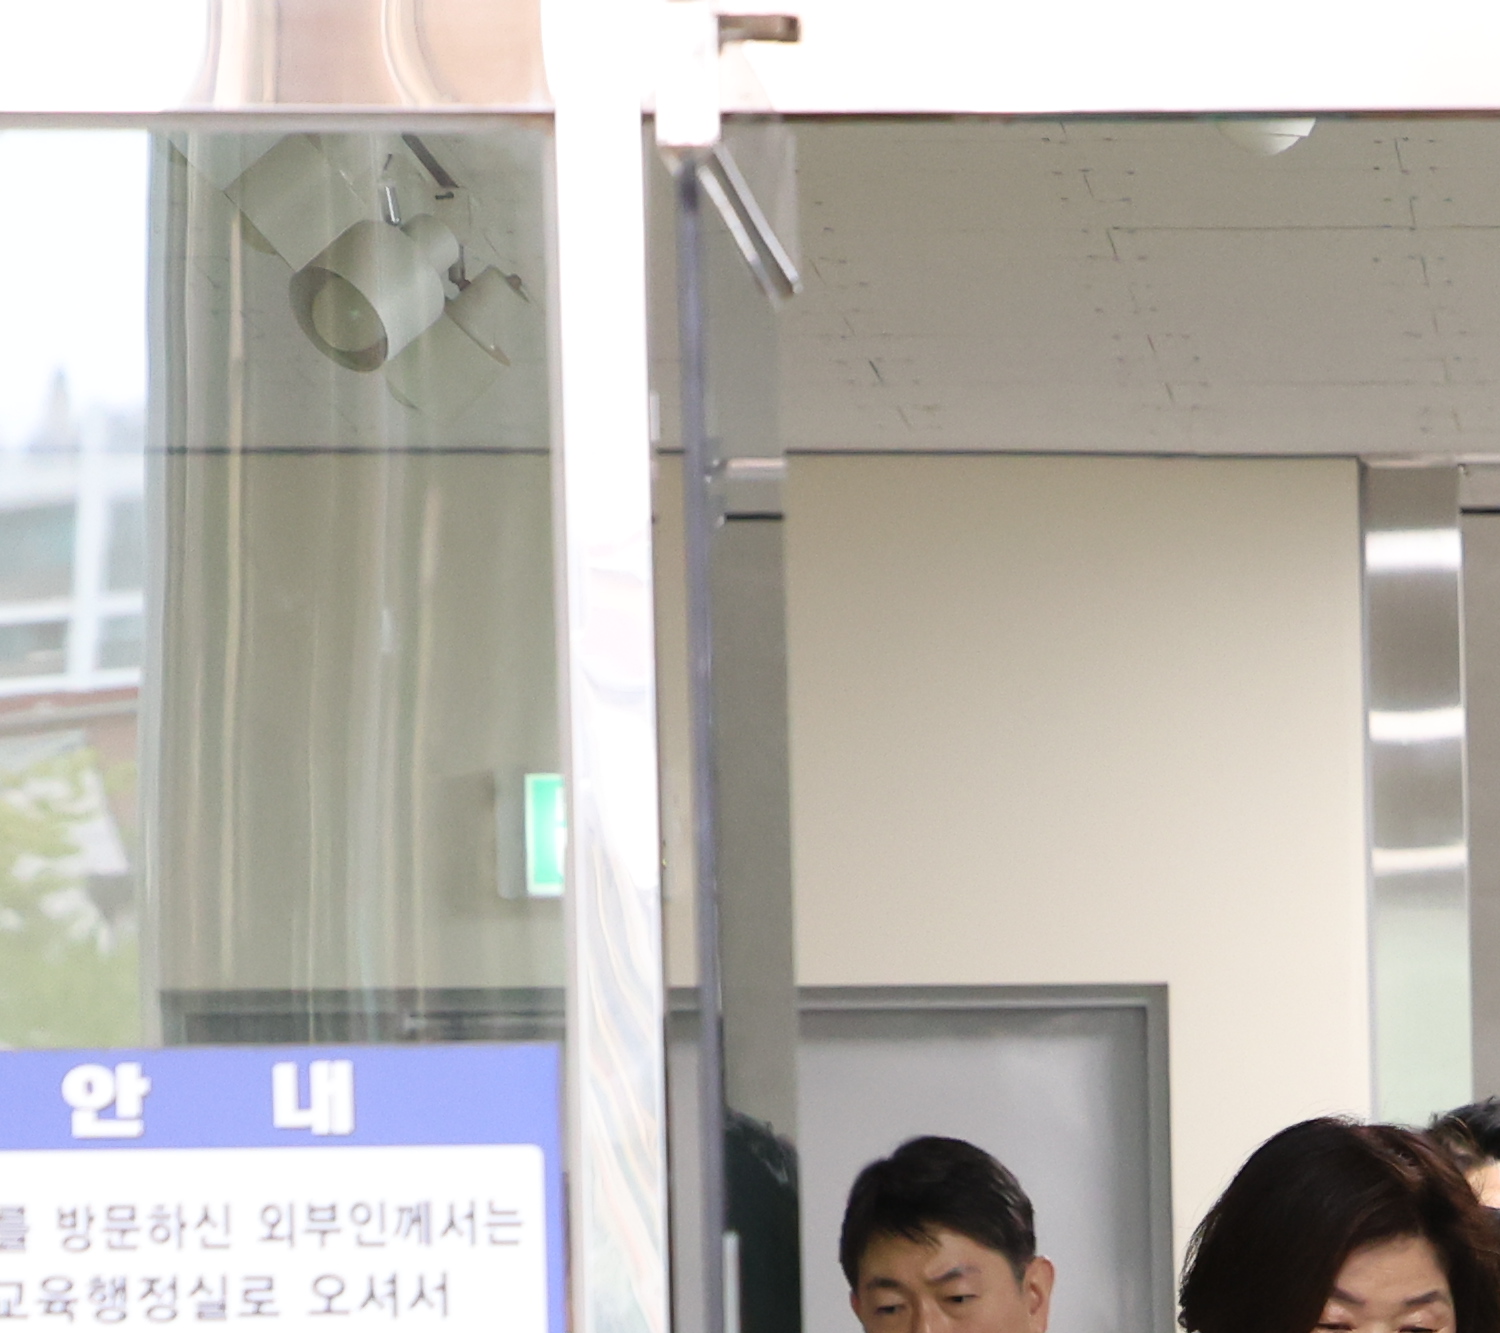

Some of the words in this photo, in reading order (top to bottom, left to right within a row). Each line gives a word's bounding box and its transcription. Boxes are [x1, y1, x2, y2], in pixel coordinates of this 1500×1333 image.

[61, 1062, 151, 1139] 안
[271, 1059, 356, 1136] 내
[57, 1201, 235, 1253] 방문하신
[258, 1199, 525, 1250] 외부인께서는
[0, 1272, 283, 1323] 교육행정실로
[307, 1271, 453, 1320] 오셔서
